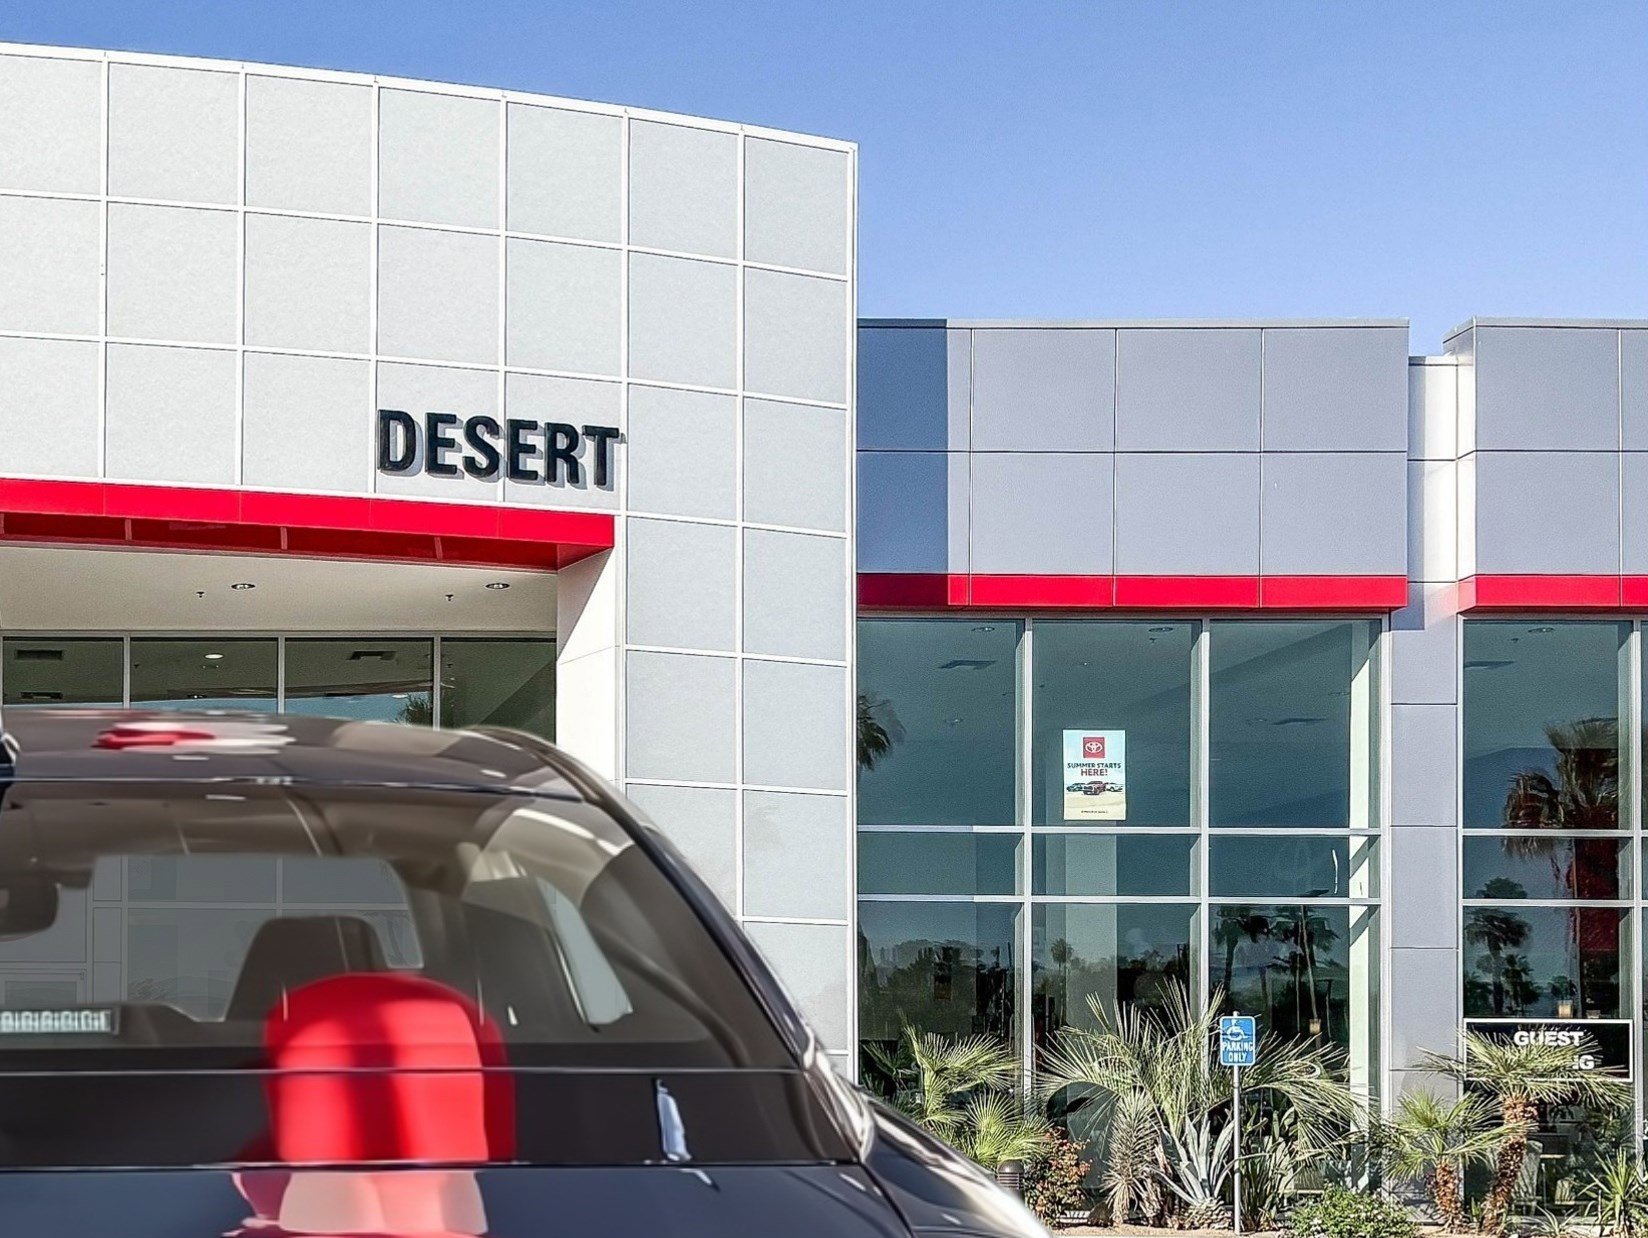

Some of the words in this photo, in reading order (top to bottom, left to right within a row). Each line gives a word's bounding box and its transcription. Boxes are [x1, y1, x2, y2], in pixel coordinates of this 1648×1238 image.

[377, 409, 620, 487] DESERT
[1080, 769, 1108, 777] HERE!
[1514, 1030, 1584, 1047] GUEST
[1222, 1041, 1253, 1052] PARKING
[1228, 1051, 1248, 1062] ONLY
